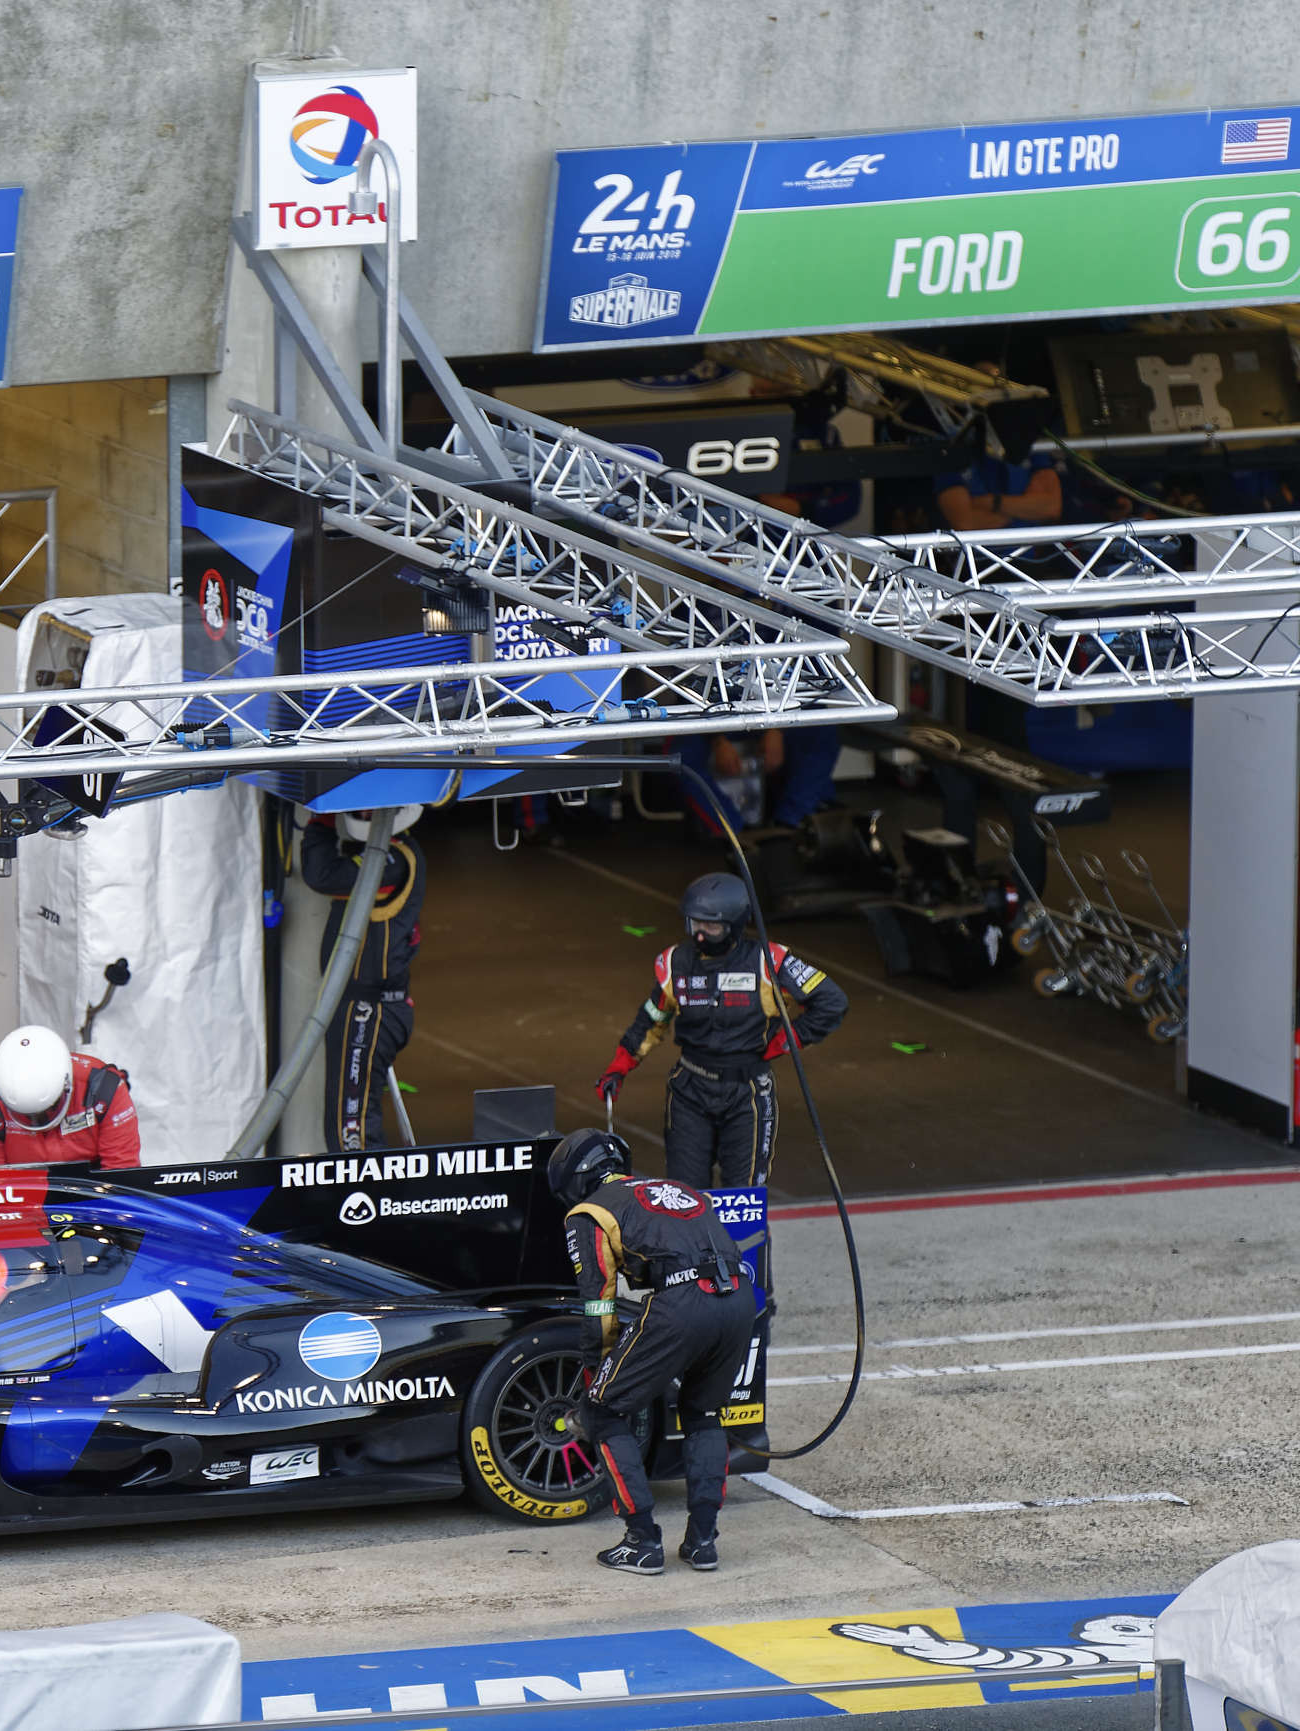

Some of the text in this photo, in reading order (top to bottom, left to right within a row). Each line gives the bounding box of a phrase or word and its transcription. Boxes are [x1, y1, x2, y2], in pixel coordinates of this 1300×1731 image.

[805, 153, 885, 178] WEC
[969, 133, 1120, 180] LM GTE PRO
[578, 169, 696, 235] 24h
[572, 232, 685, 253] LE MANS
[1196, 207, 1292, 277] 66
[887, 230, 1023, 299] FORD
[571, 286, 679, 325] SUPERFINALE
[686, 436, 780, 476] 66
[154, 1168, 238, 1185] JOTA Sport
[281, 1146, 533, 1188] RICHARD MILLE
[380, 1191, 508, 1218] Basecamp.com
[712, 1193, 763, 1207] OTAL
[666, 1268, 699, 1288] MRTC
[235, 1376, 455, 1413] KONICA MINOLTA
[265, 1450, 318, 1471] WEC
[473, 1440, 559, 1517] DUNLOP
